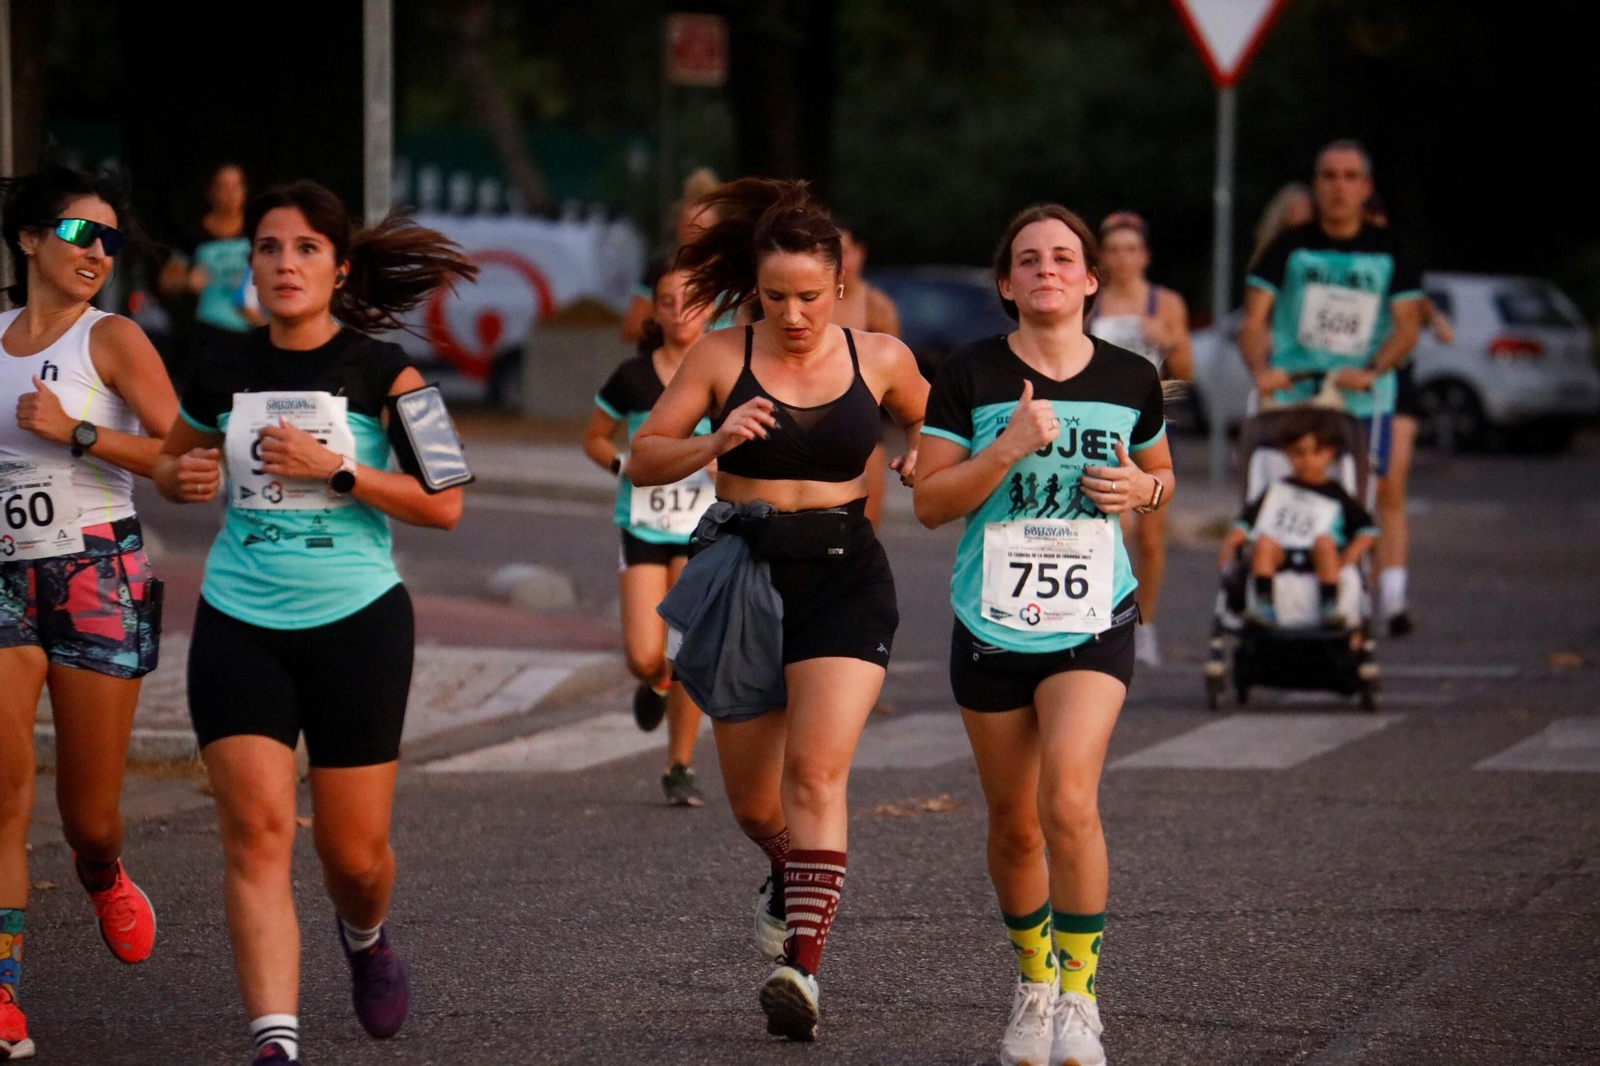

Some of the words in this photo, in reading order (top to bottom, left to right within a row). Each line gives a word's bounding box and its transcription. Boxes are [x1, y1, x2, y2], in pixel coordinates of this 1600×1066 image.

[0, 491, 54, 530] 60
[649, 488, 700, 512] 617
[1009, 562, 1089, 600] 756
